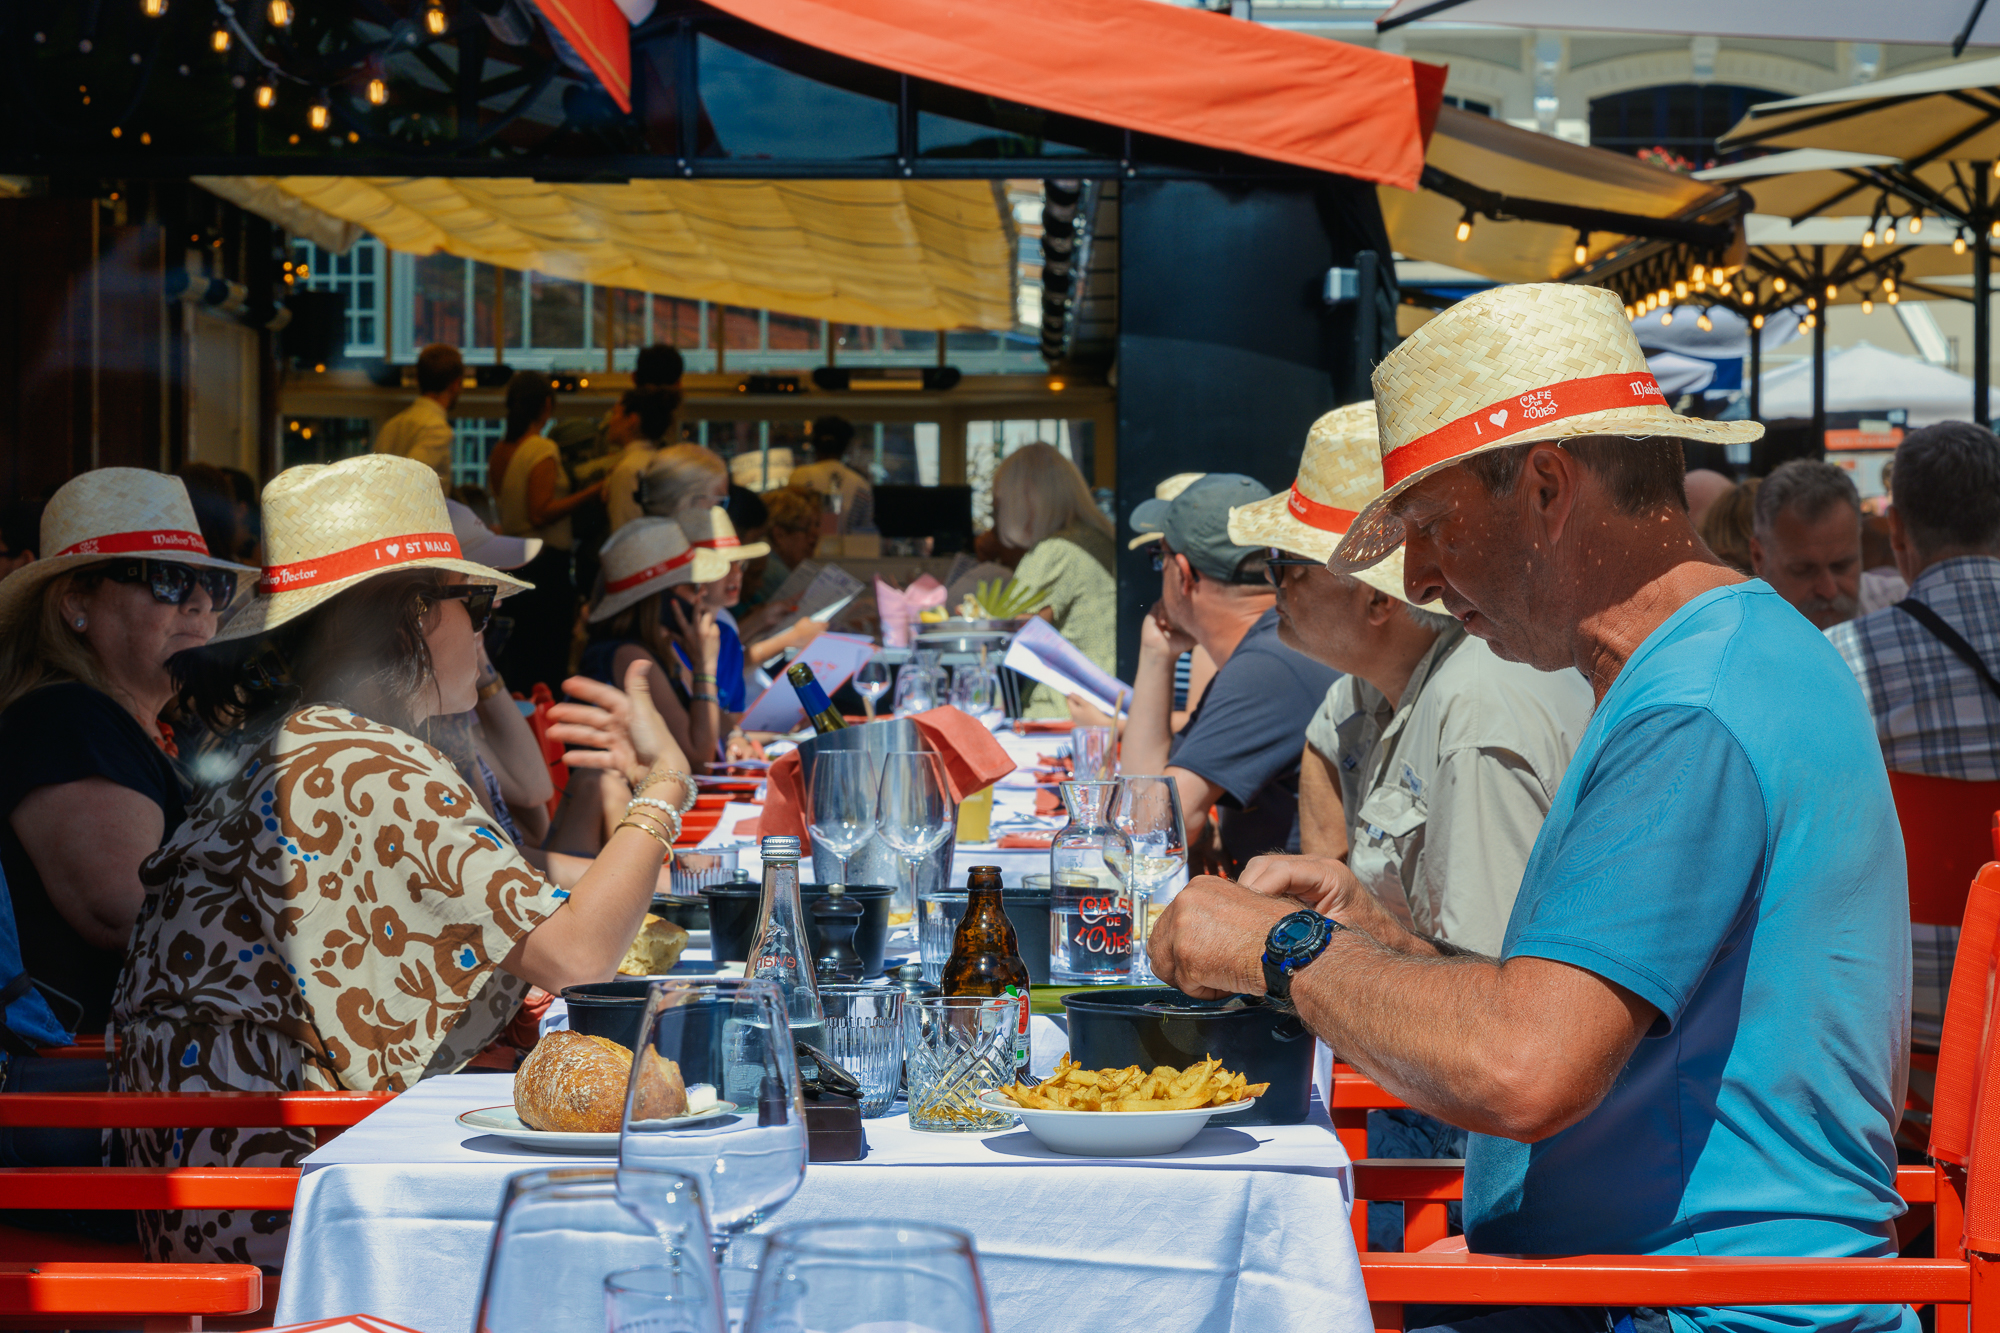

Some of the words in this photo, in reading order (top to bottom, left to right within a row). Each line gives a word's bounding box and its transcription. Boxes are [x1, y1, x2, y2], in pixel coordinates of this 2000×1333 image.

[1520, 390, 1552, 408] CAFÉ
[1473, 421, 1483, 435] I
[374, 548, 381, 560] I
[405, 541, 422, 554] ST
[424, 541, 452, 553] MALO
[1106, 917, 1121, 927] DE
